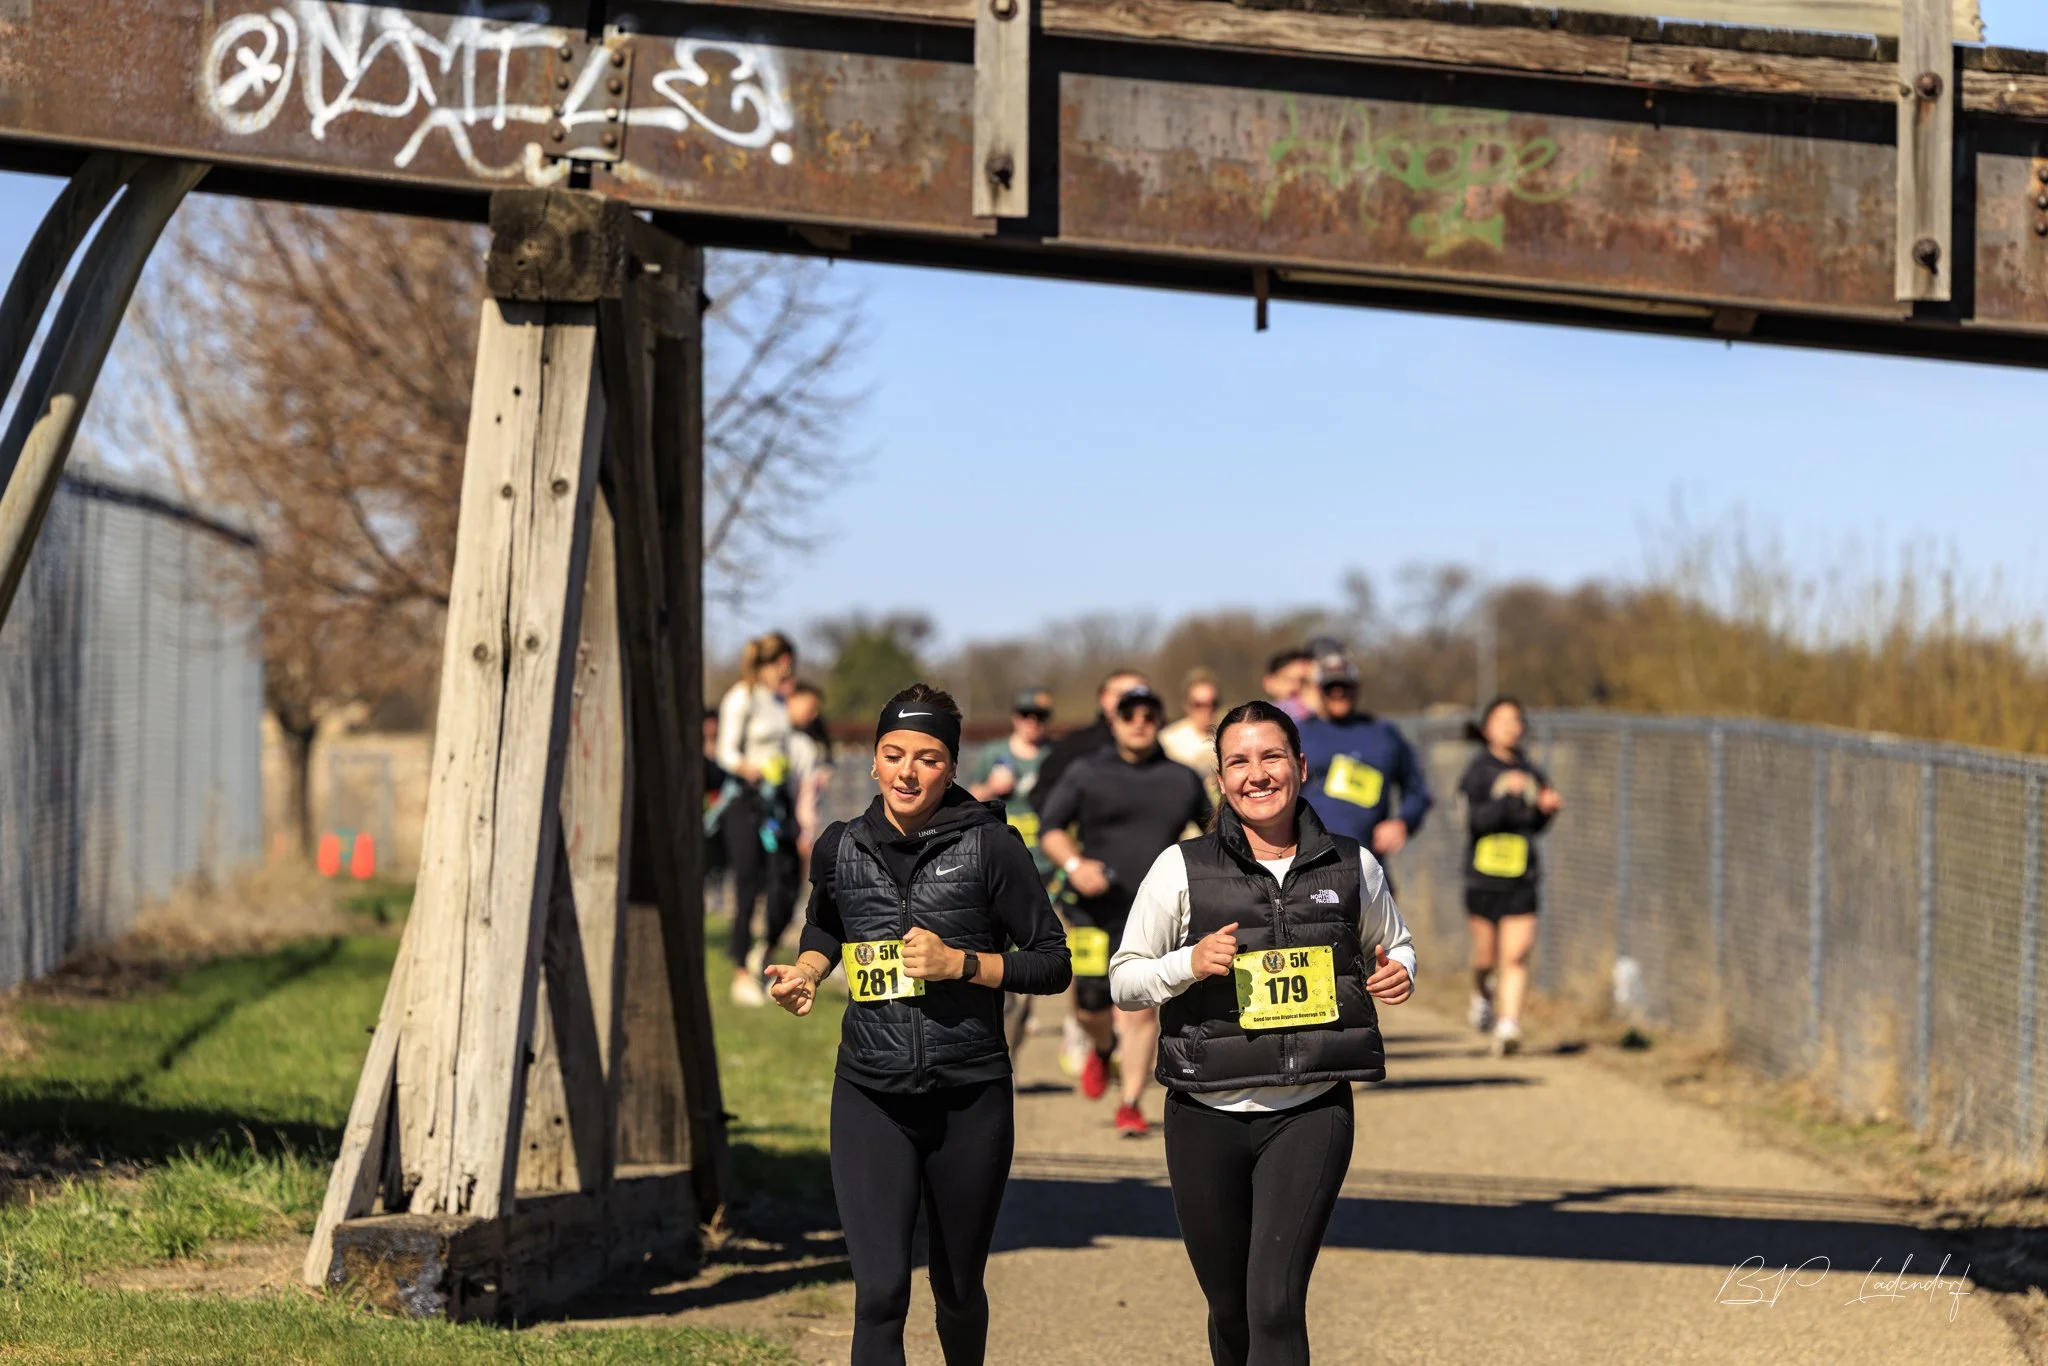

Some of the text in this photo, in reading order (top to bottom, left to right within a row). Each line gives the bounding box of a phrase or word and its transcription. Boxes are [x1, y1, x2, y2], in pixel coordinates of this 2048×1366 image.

[918, 828, 938, 838] UNRL
[879, 944, 900, 961] 5K
[1290, 952, 1309, 968] 5K
[857, 967, 899, 997] 281
[1264, 975, 1309, 1005] 179
